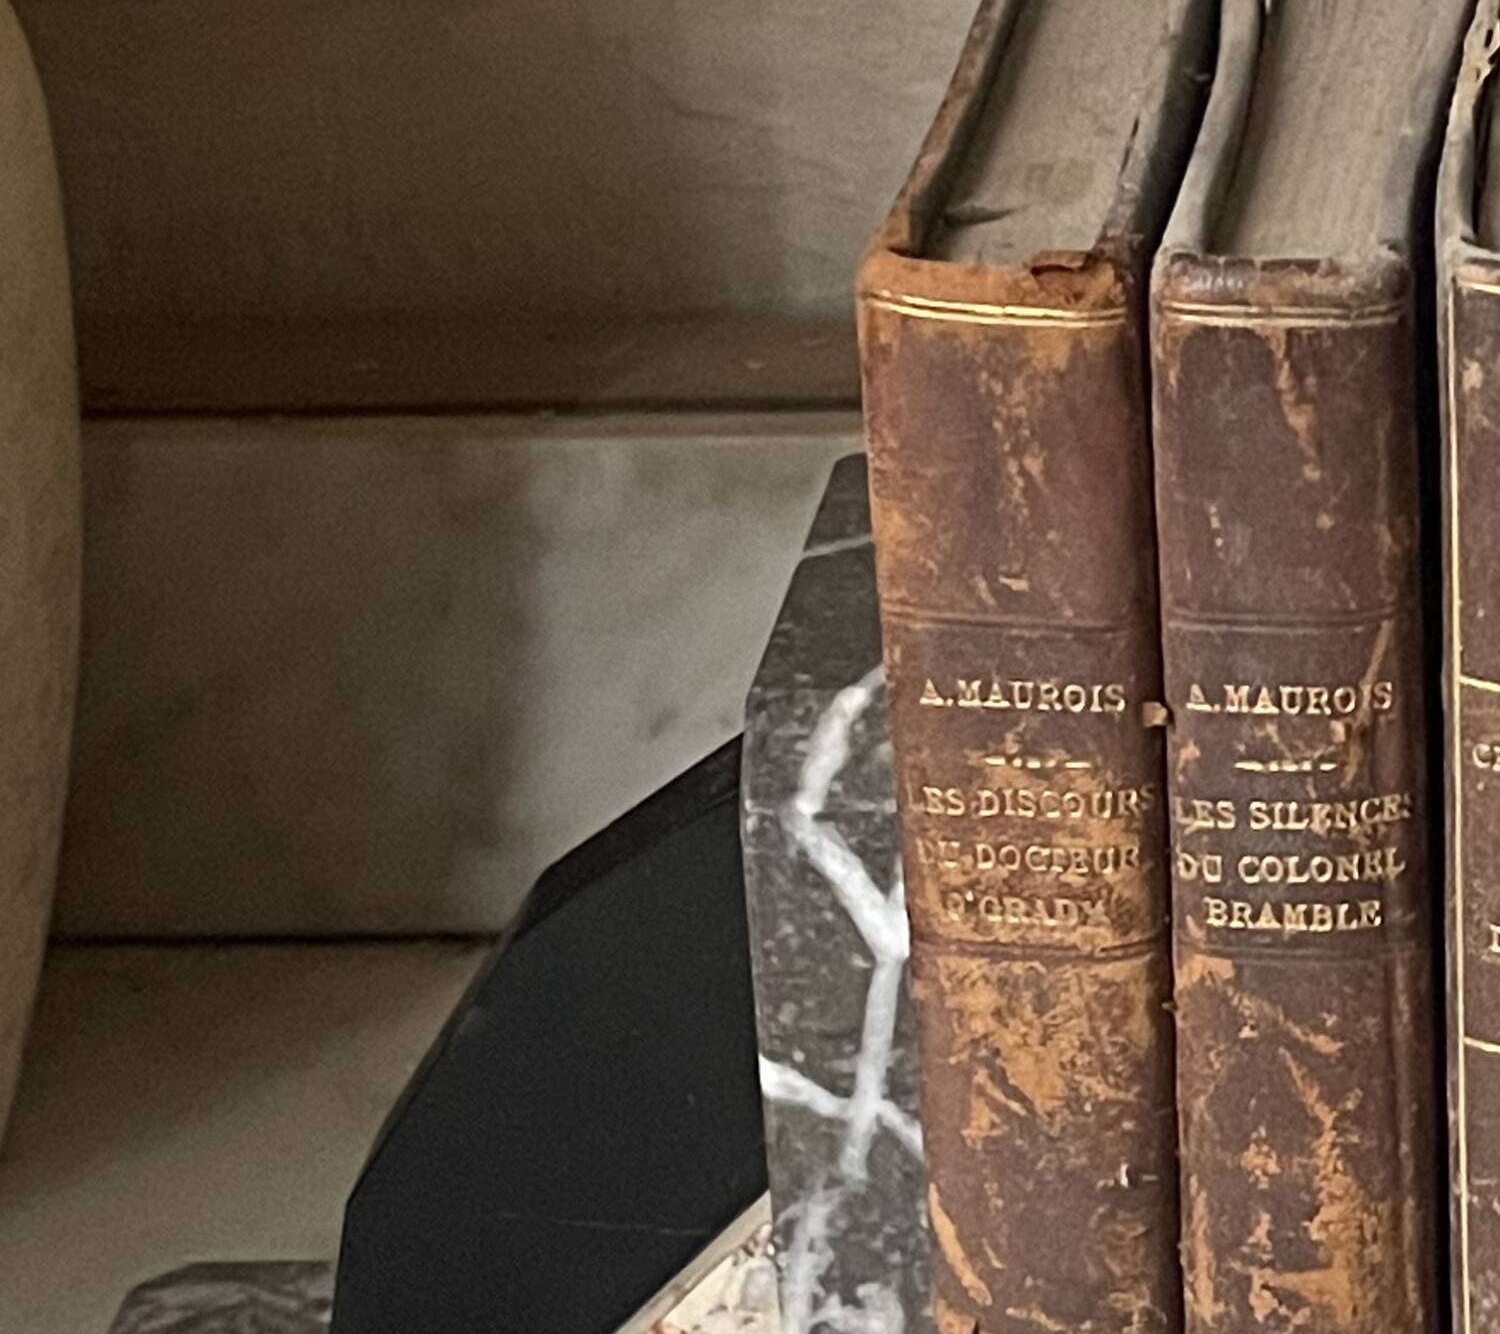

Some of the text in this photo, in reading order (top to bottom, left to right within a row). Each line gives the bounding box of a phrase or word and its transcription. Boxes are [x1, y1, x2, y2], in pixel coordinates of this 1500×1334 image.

[907, 782, 1156, 819] LES DISCOURS
[1174, 796, 1236, 830] LES
[976, 843, 1140, 875] DOCTEUR
[1176, 847, 1406, 884] DU COLONEL
[1203, 898, 1382, 932] BRAMBLE
